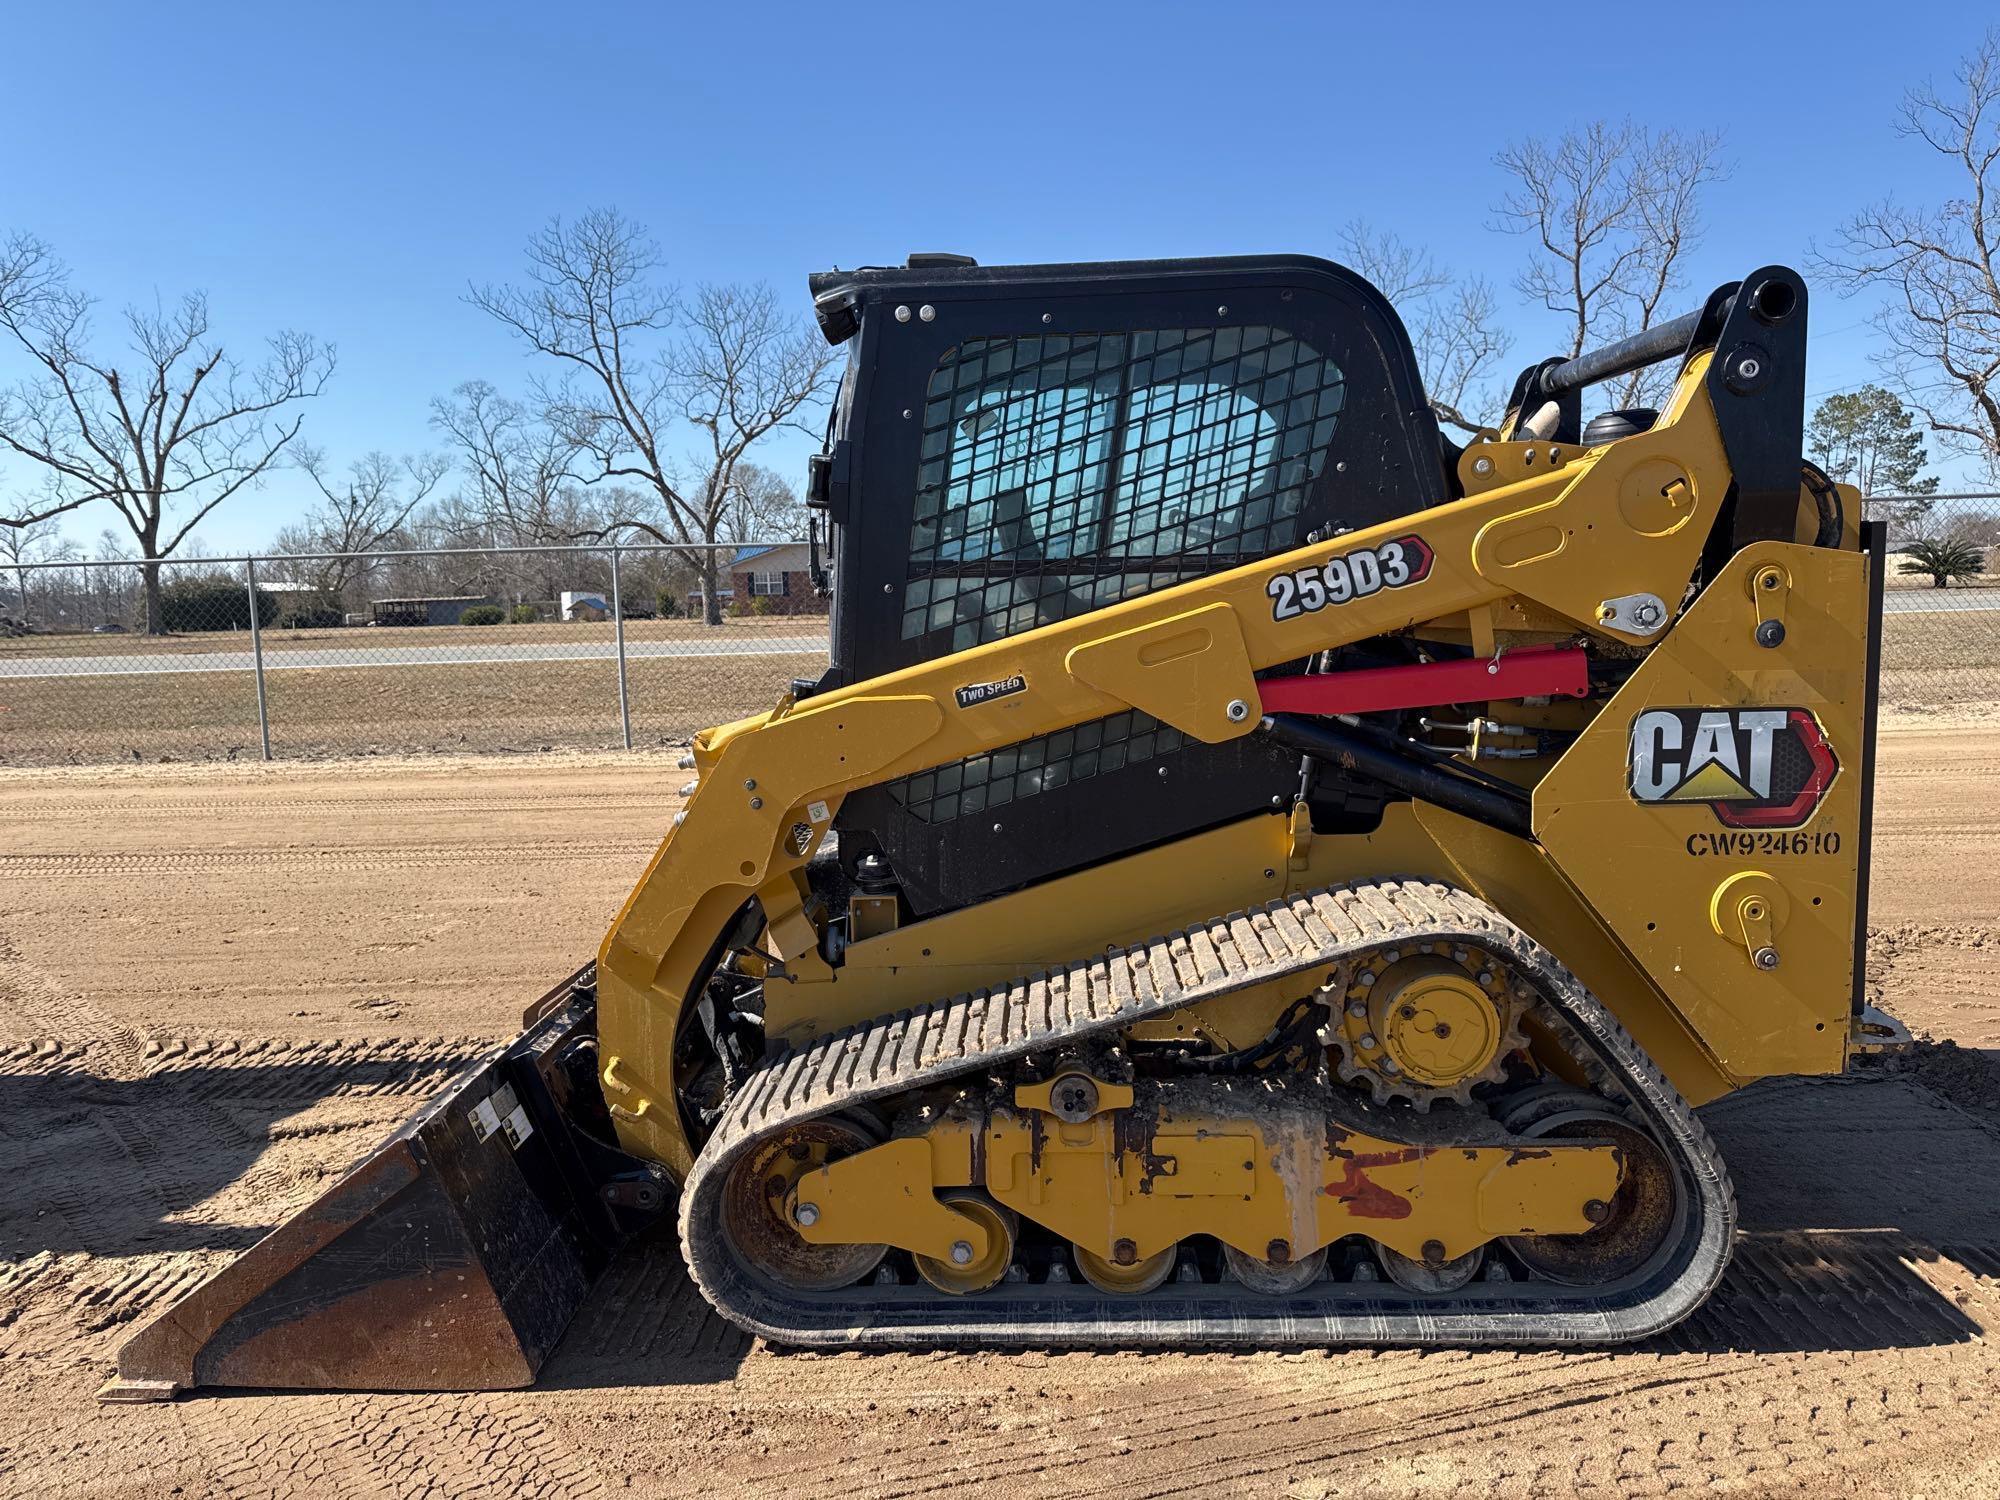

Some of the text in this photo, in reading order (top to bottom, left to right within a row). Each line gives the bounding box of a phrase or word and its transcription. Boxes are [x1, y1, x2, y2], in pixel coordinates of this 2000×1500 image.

[1269, 542, 1410, 619] 259D3
[961, 679, 1020, 703] TWO SPEED
[1633, 710, 1788, 801] CAT
[1686, 832, 1841, 856] CW924610
